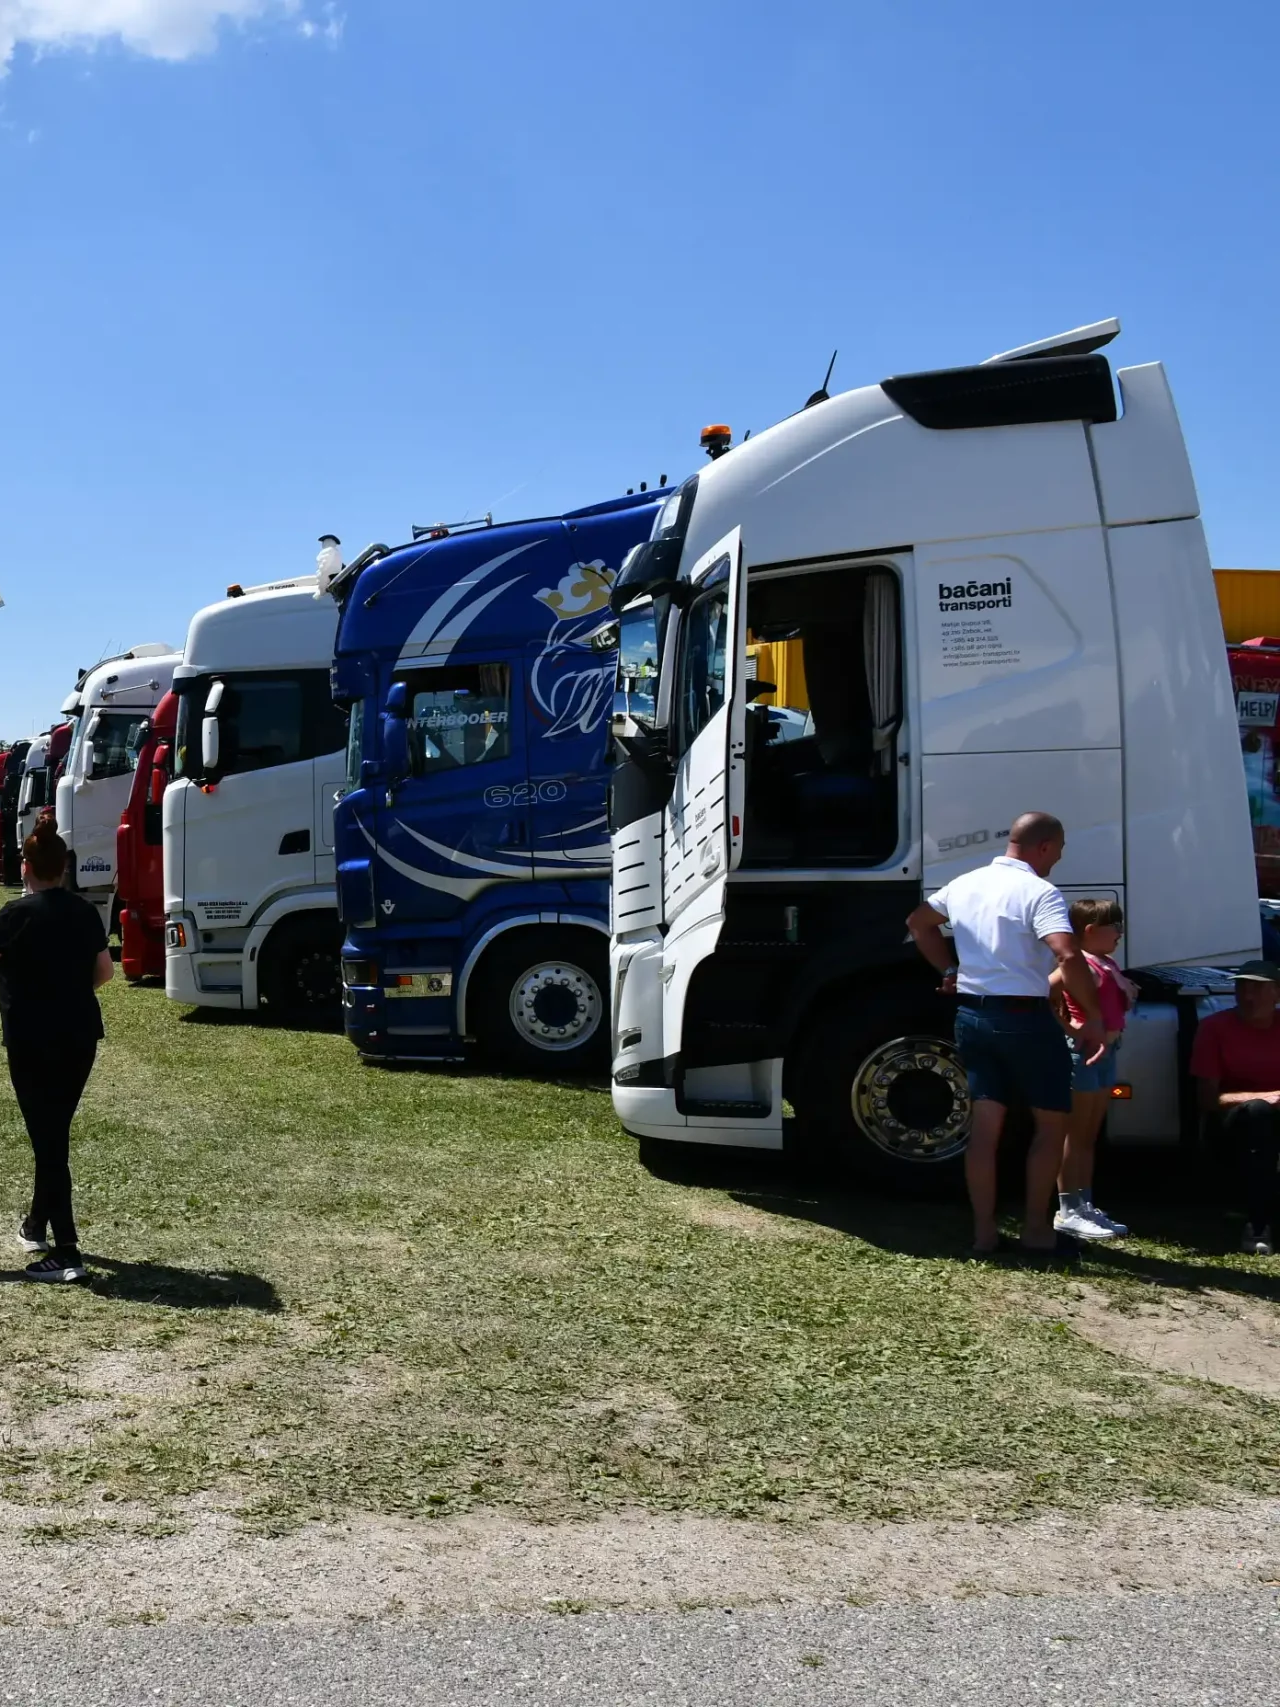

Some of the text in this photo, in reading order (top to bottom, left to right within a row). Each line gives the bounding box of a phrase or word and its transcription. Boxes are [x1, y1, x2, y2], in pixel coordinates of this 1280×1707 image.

[938, 596, 1012, 612] transporti
[483, 780, 567, 808] 620
[938, 829, 989, 852] 500
